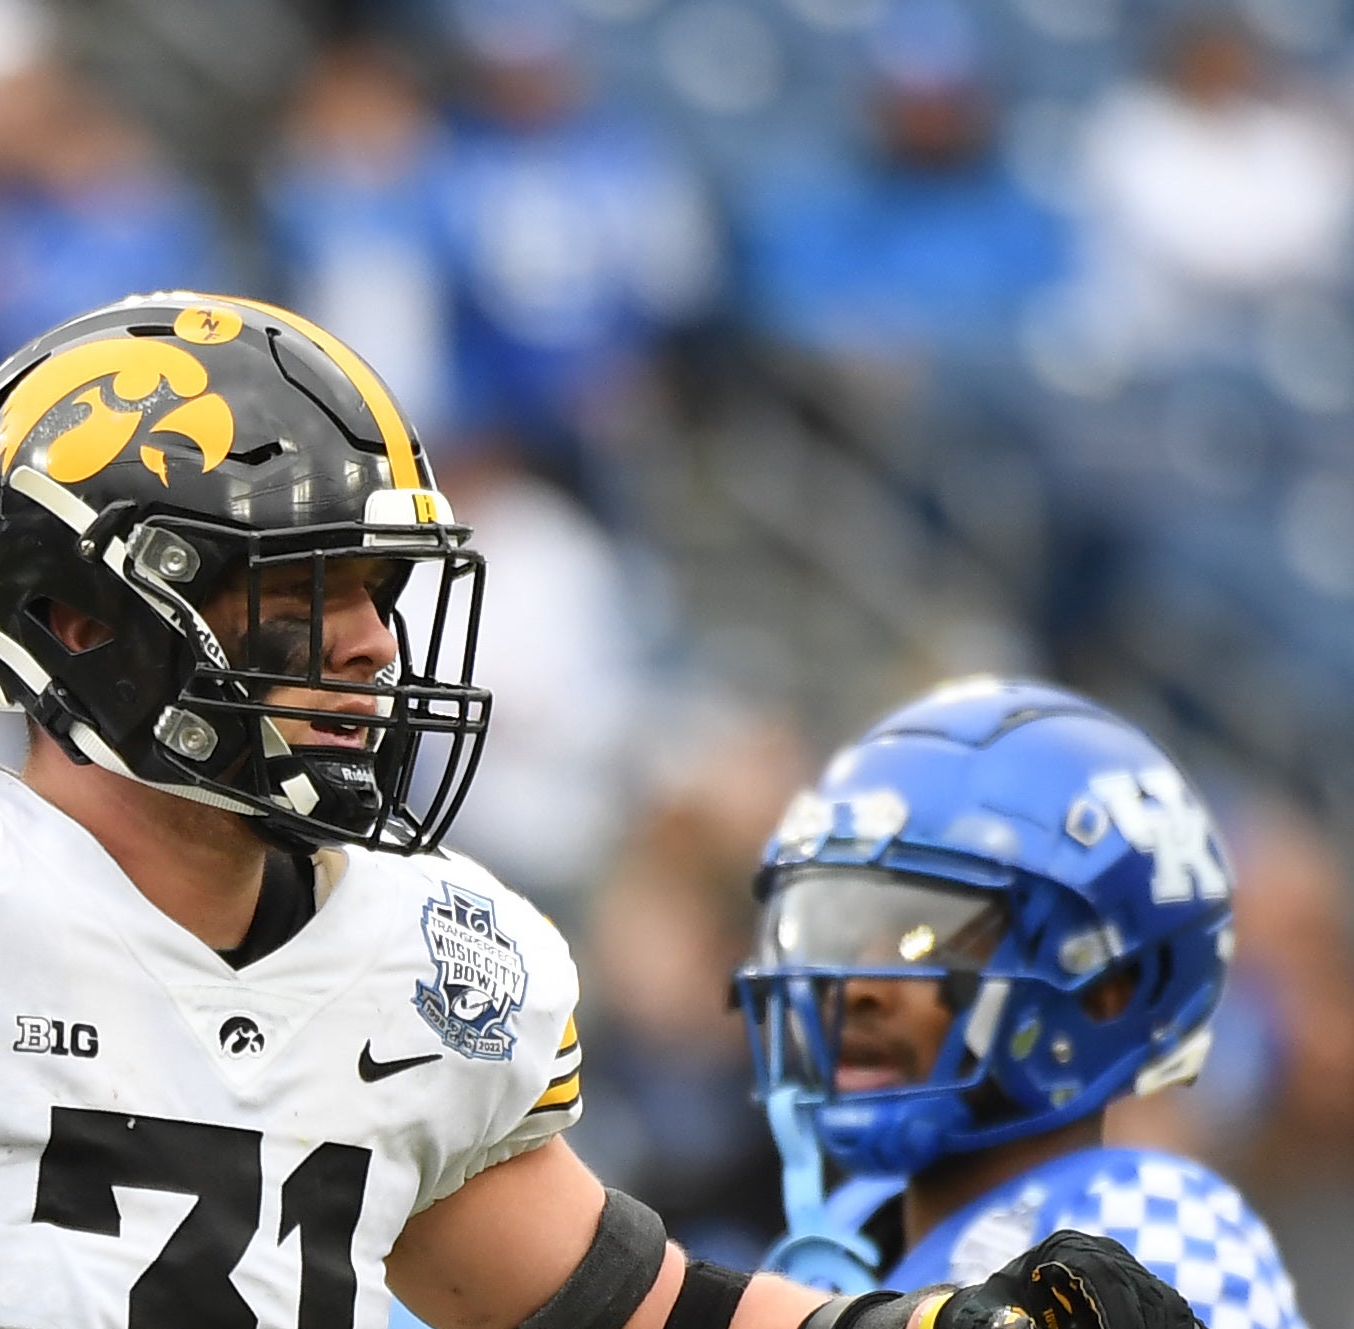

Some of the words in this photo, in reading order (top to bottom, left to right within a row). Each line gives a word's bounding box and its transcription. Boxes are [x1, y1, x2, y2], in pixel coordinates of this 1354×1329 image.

[430, 930, 483, 969] MUSIC
[484, 956, 522, 994] CITY
[452, 961, 500, 1002] BOWL
[478, 1040, 501, 1053] 2022
